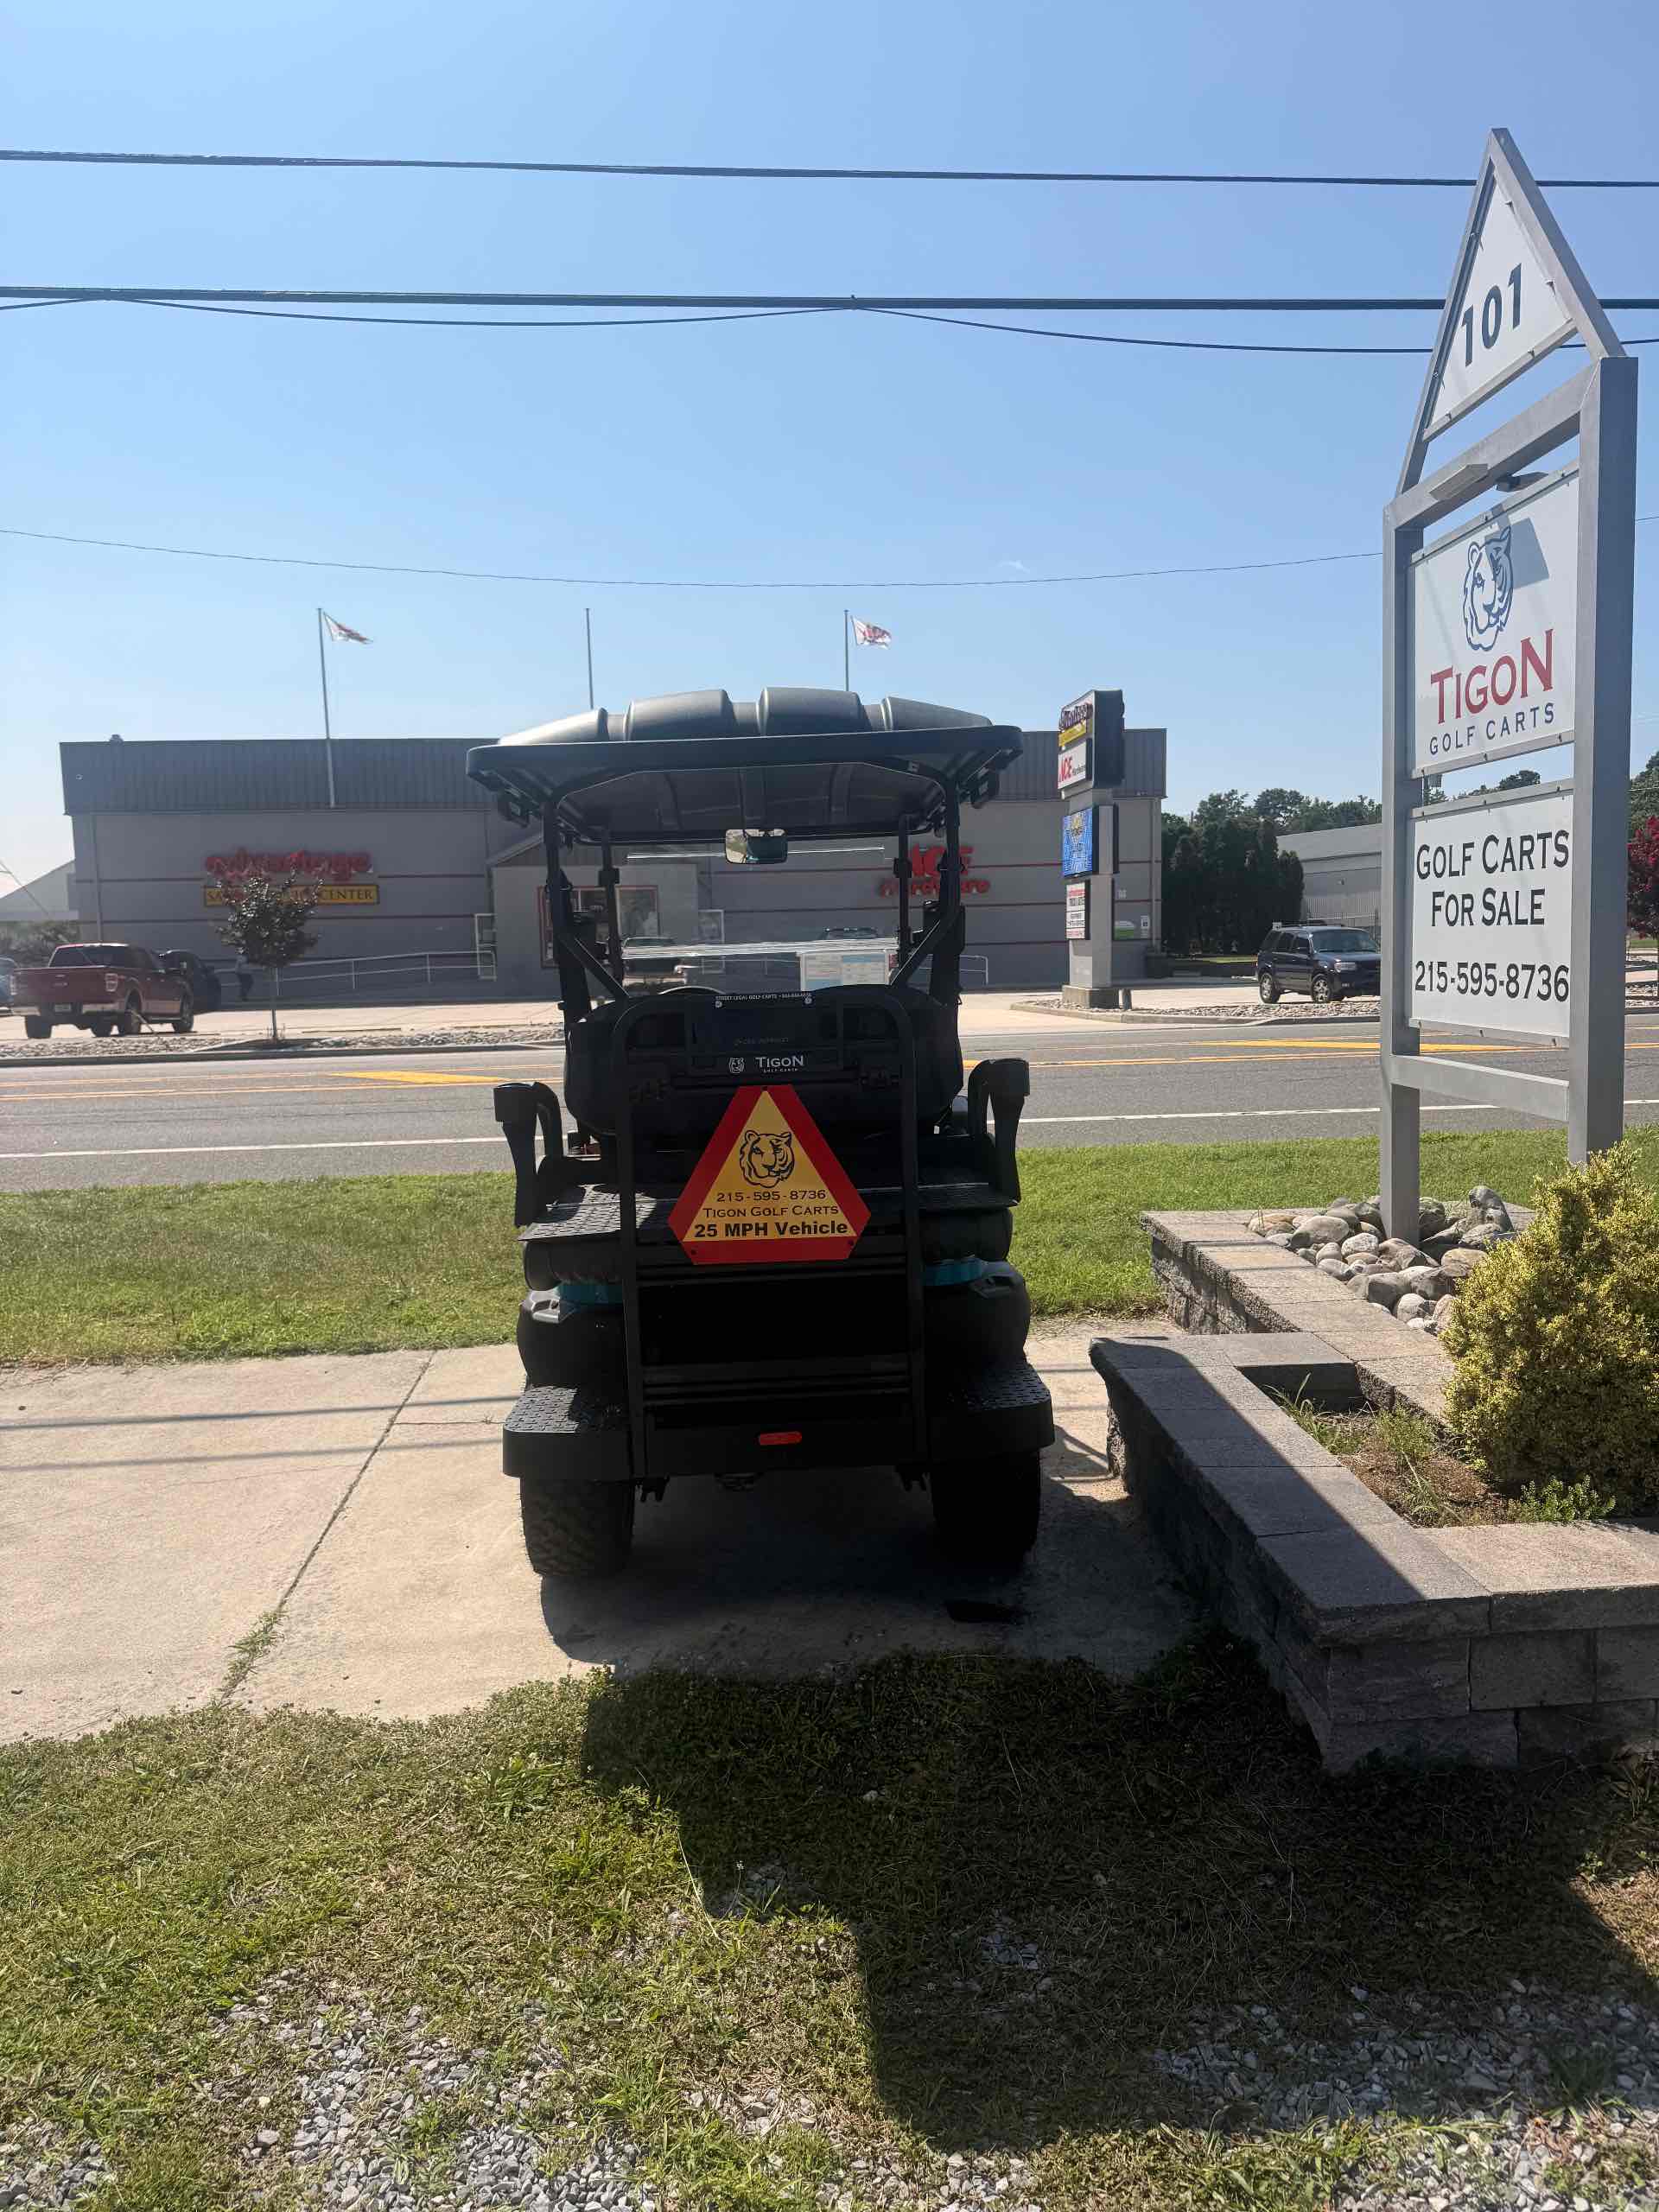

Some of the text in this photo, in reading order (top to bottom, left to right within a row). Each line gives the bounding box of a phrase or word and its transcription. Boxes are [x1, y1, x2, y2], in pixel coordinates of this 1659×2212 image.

[1461, 262, 1522, 367] 101
[1430, 627, 1554, 724] TIGON
[1428, 702, 1555, 756] GOLF CARTS
[1416, 830, 1570, 880] GOLF CARTS
[1431, 887, 1546, 927] FOR SALE
[1414, 960, 1570, 1002] 215-595-8736
[755, 1055, 804, 1067] TIGON
[694, 1220, 849, 1238] 25 MPH Vehicle
[702, 1205, 840, 1218] TIGON GOLF CARTS
